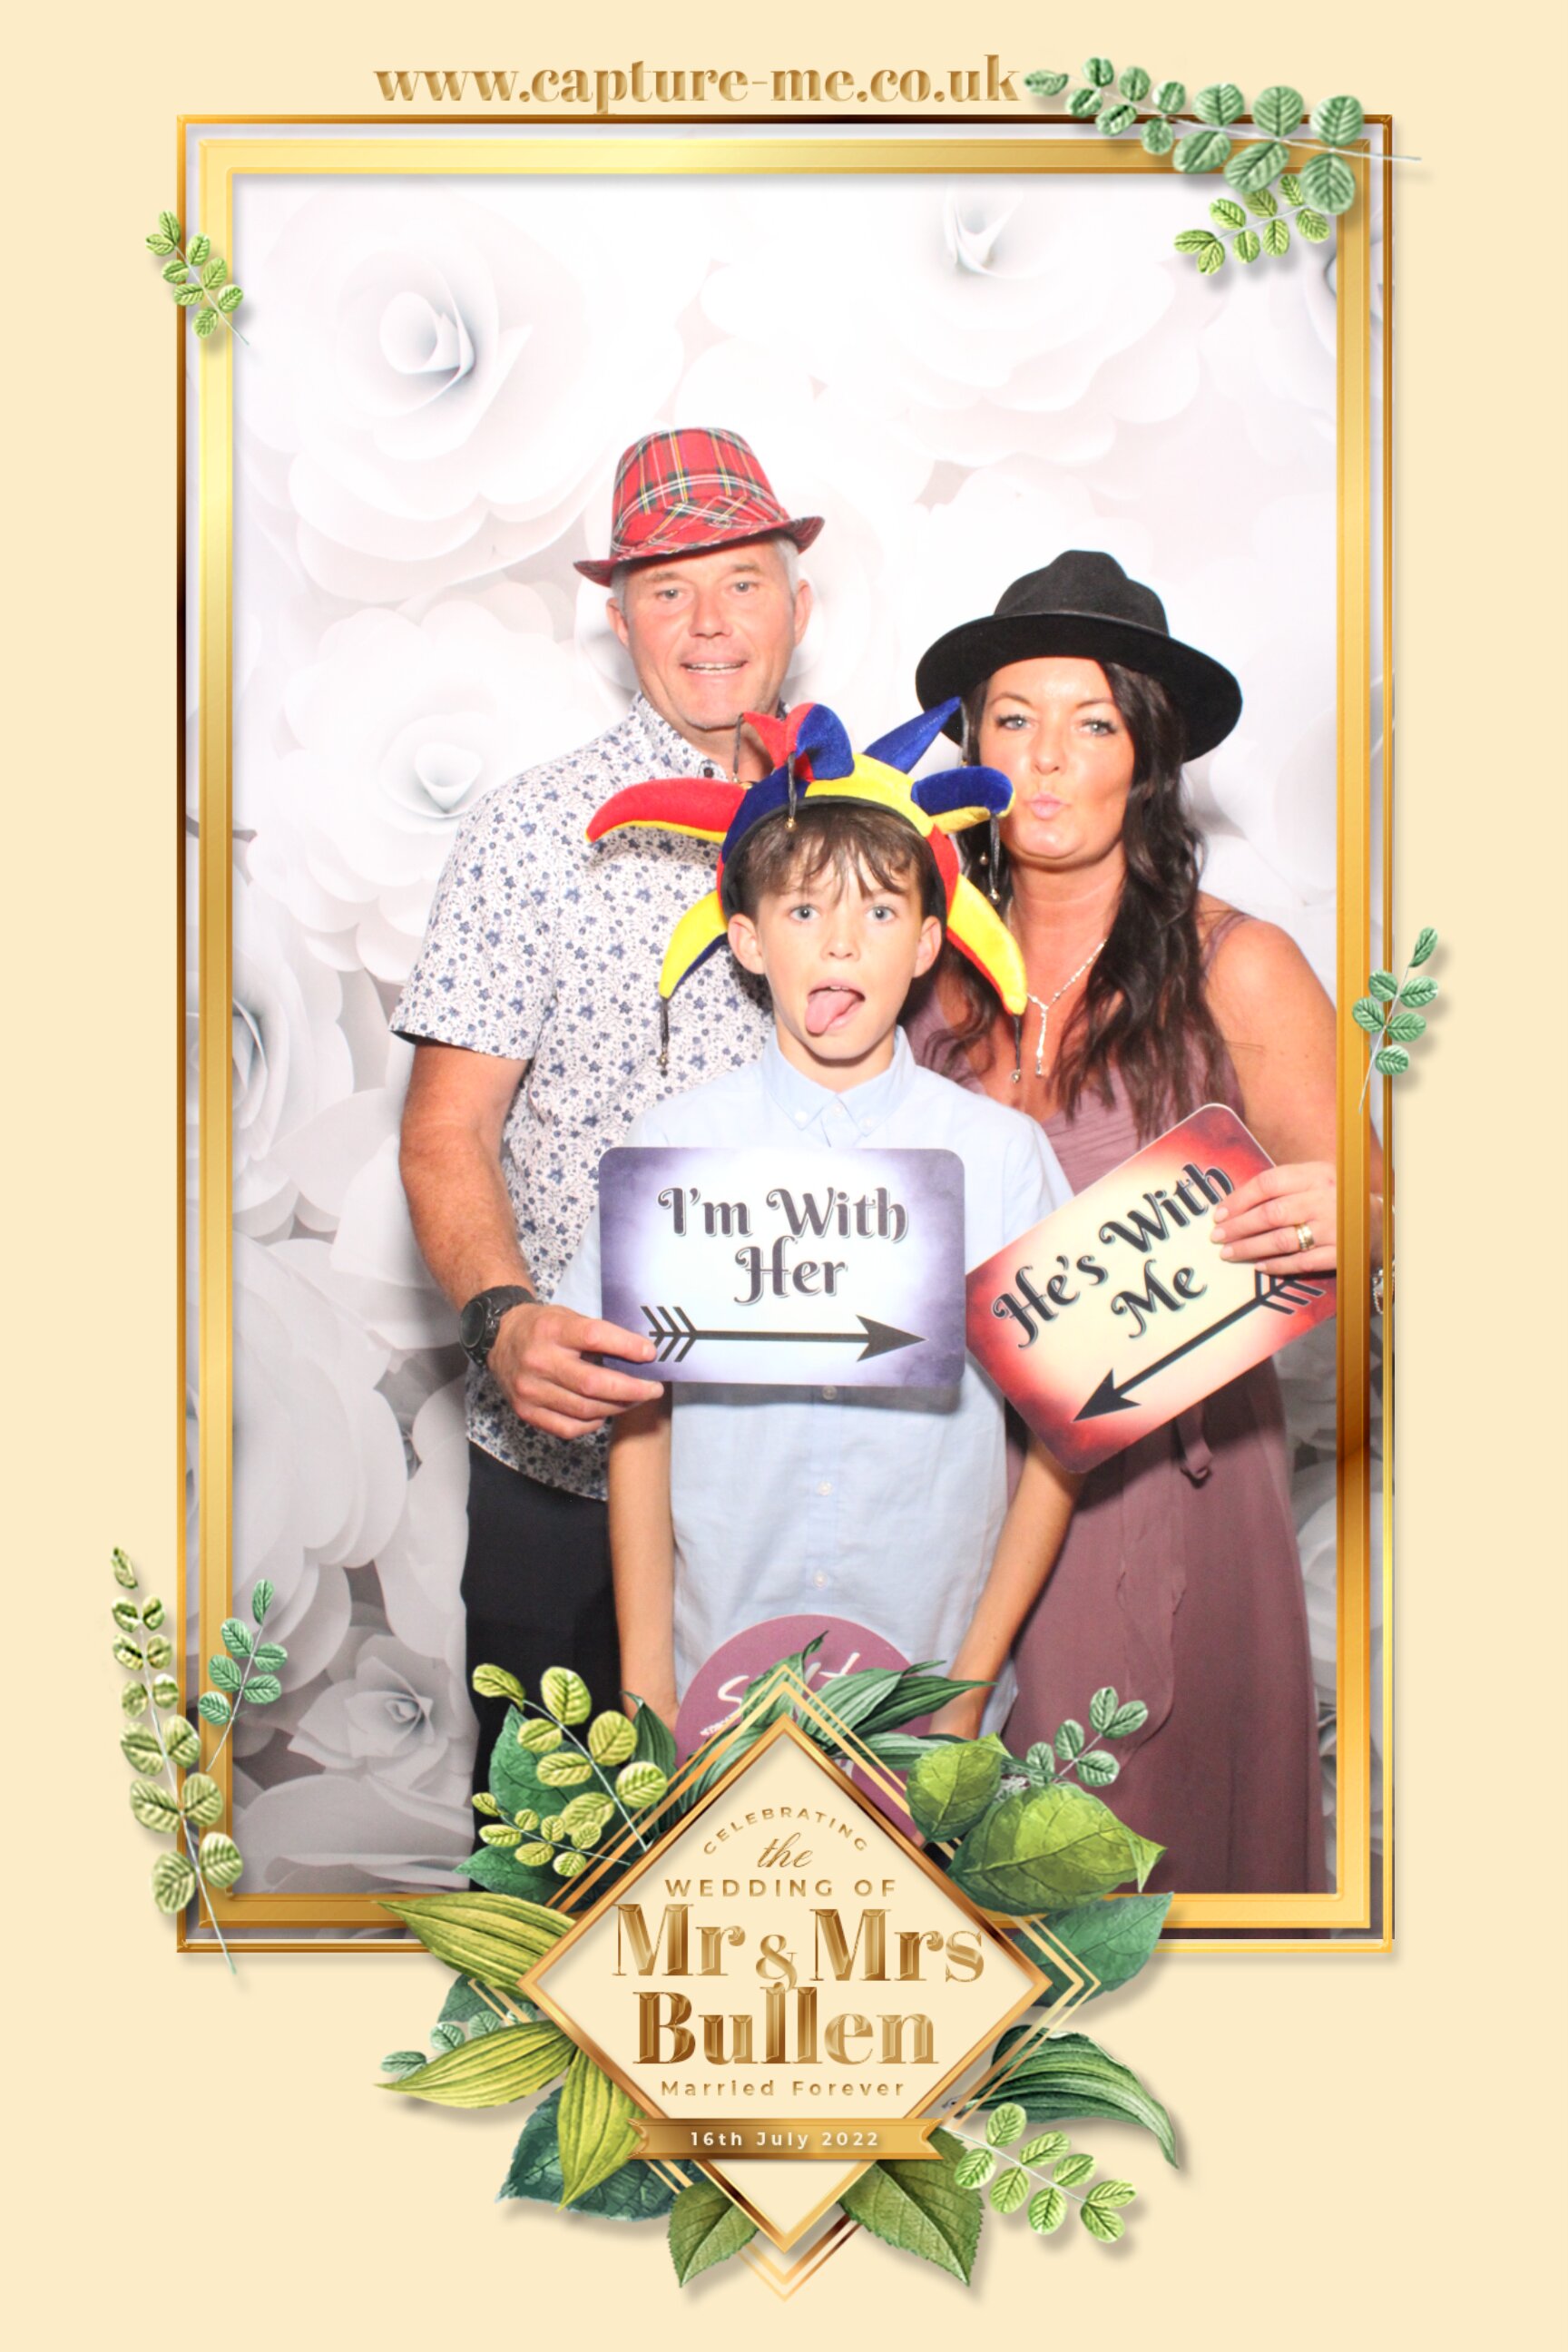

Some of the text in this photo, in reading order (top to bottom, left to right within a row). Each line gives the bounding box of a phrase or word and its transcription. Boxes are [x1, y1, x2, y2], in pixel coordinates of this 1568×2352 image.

[658, 1186, 908, 1242] I'm With
[733, 1234, 848, 1305] Her
[992, 1162, 1235, 1349] He's With
[1111, 1259, 1209, 1339] Me
